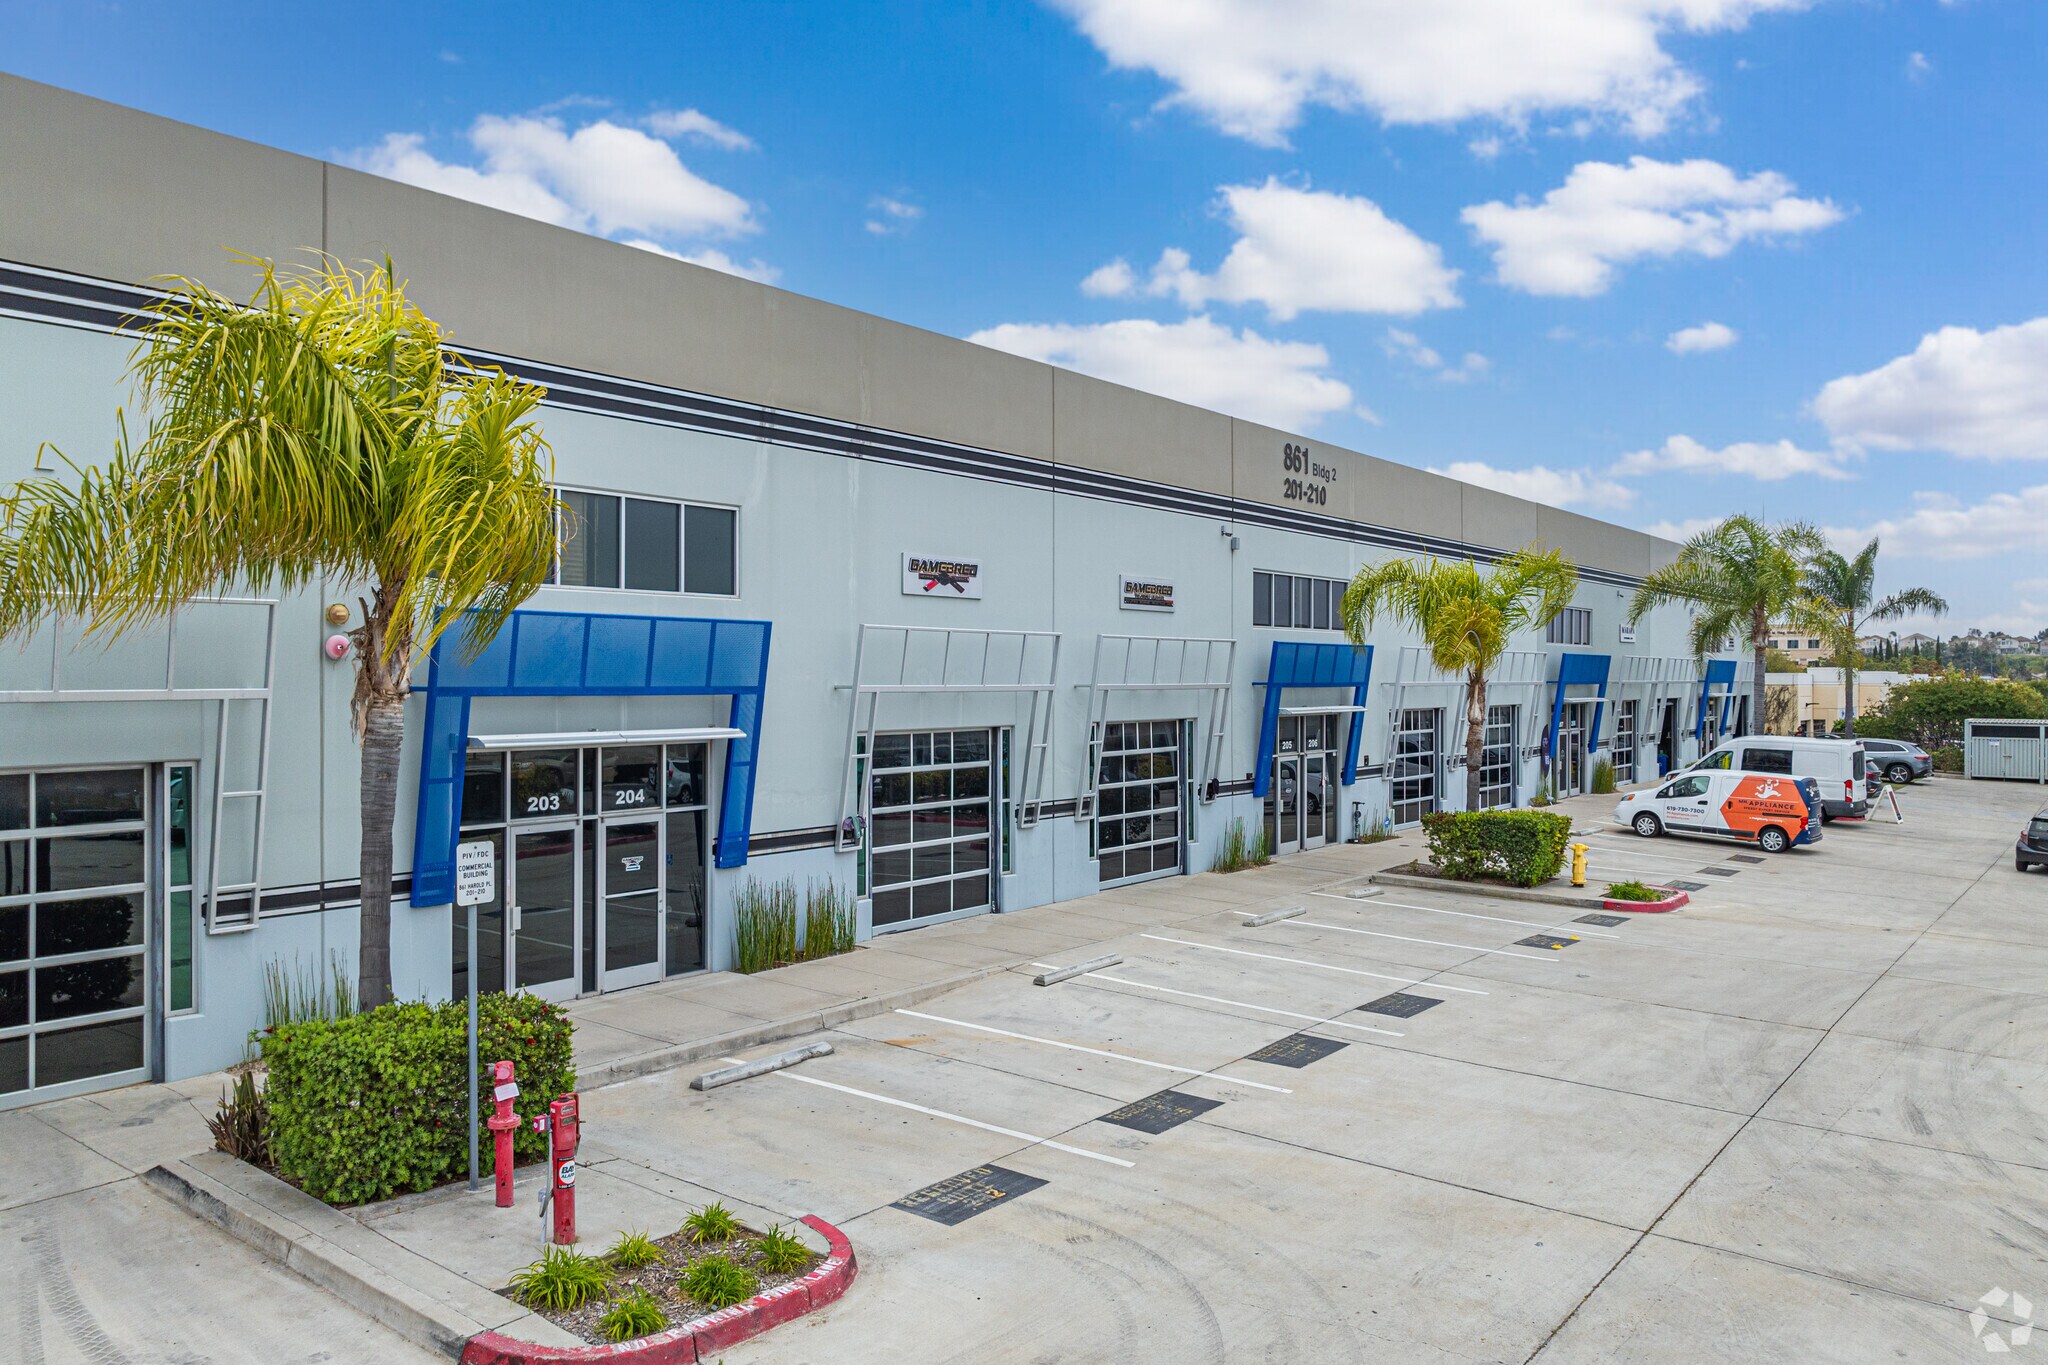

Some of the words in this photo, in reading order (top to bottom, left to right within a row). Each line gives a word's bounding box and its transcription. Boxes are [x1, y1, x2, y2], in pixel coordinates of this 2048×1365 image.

[1283, 443, 1309, 475] 861
[1312, 463, 1330, 483] Bldg
[1332, 468, 1337, 481] 2
[1283, 478, 1327, 506] 201-210
[1282, 741, 1293, 750] 205
[1308, 739, 1318, 748] 206
[615, 788, 645, 805] 204
[527, 795, 560, 812] 203
[1748, 801, 1795, 810] APPLIANCE
[458, 862, 493, 872] COMMERCIAL
[463, 870, 489, 879] BUILDING
[467, 881, 485, 889] HAROLD
[465, 888, 486, 897] 201-210
[900, 1167, 993, 1207] RESERVED
